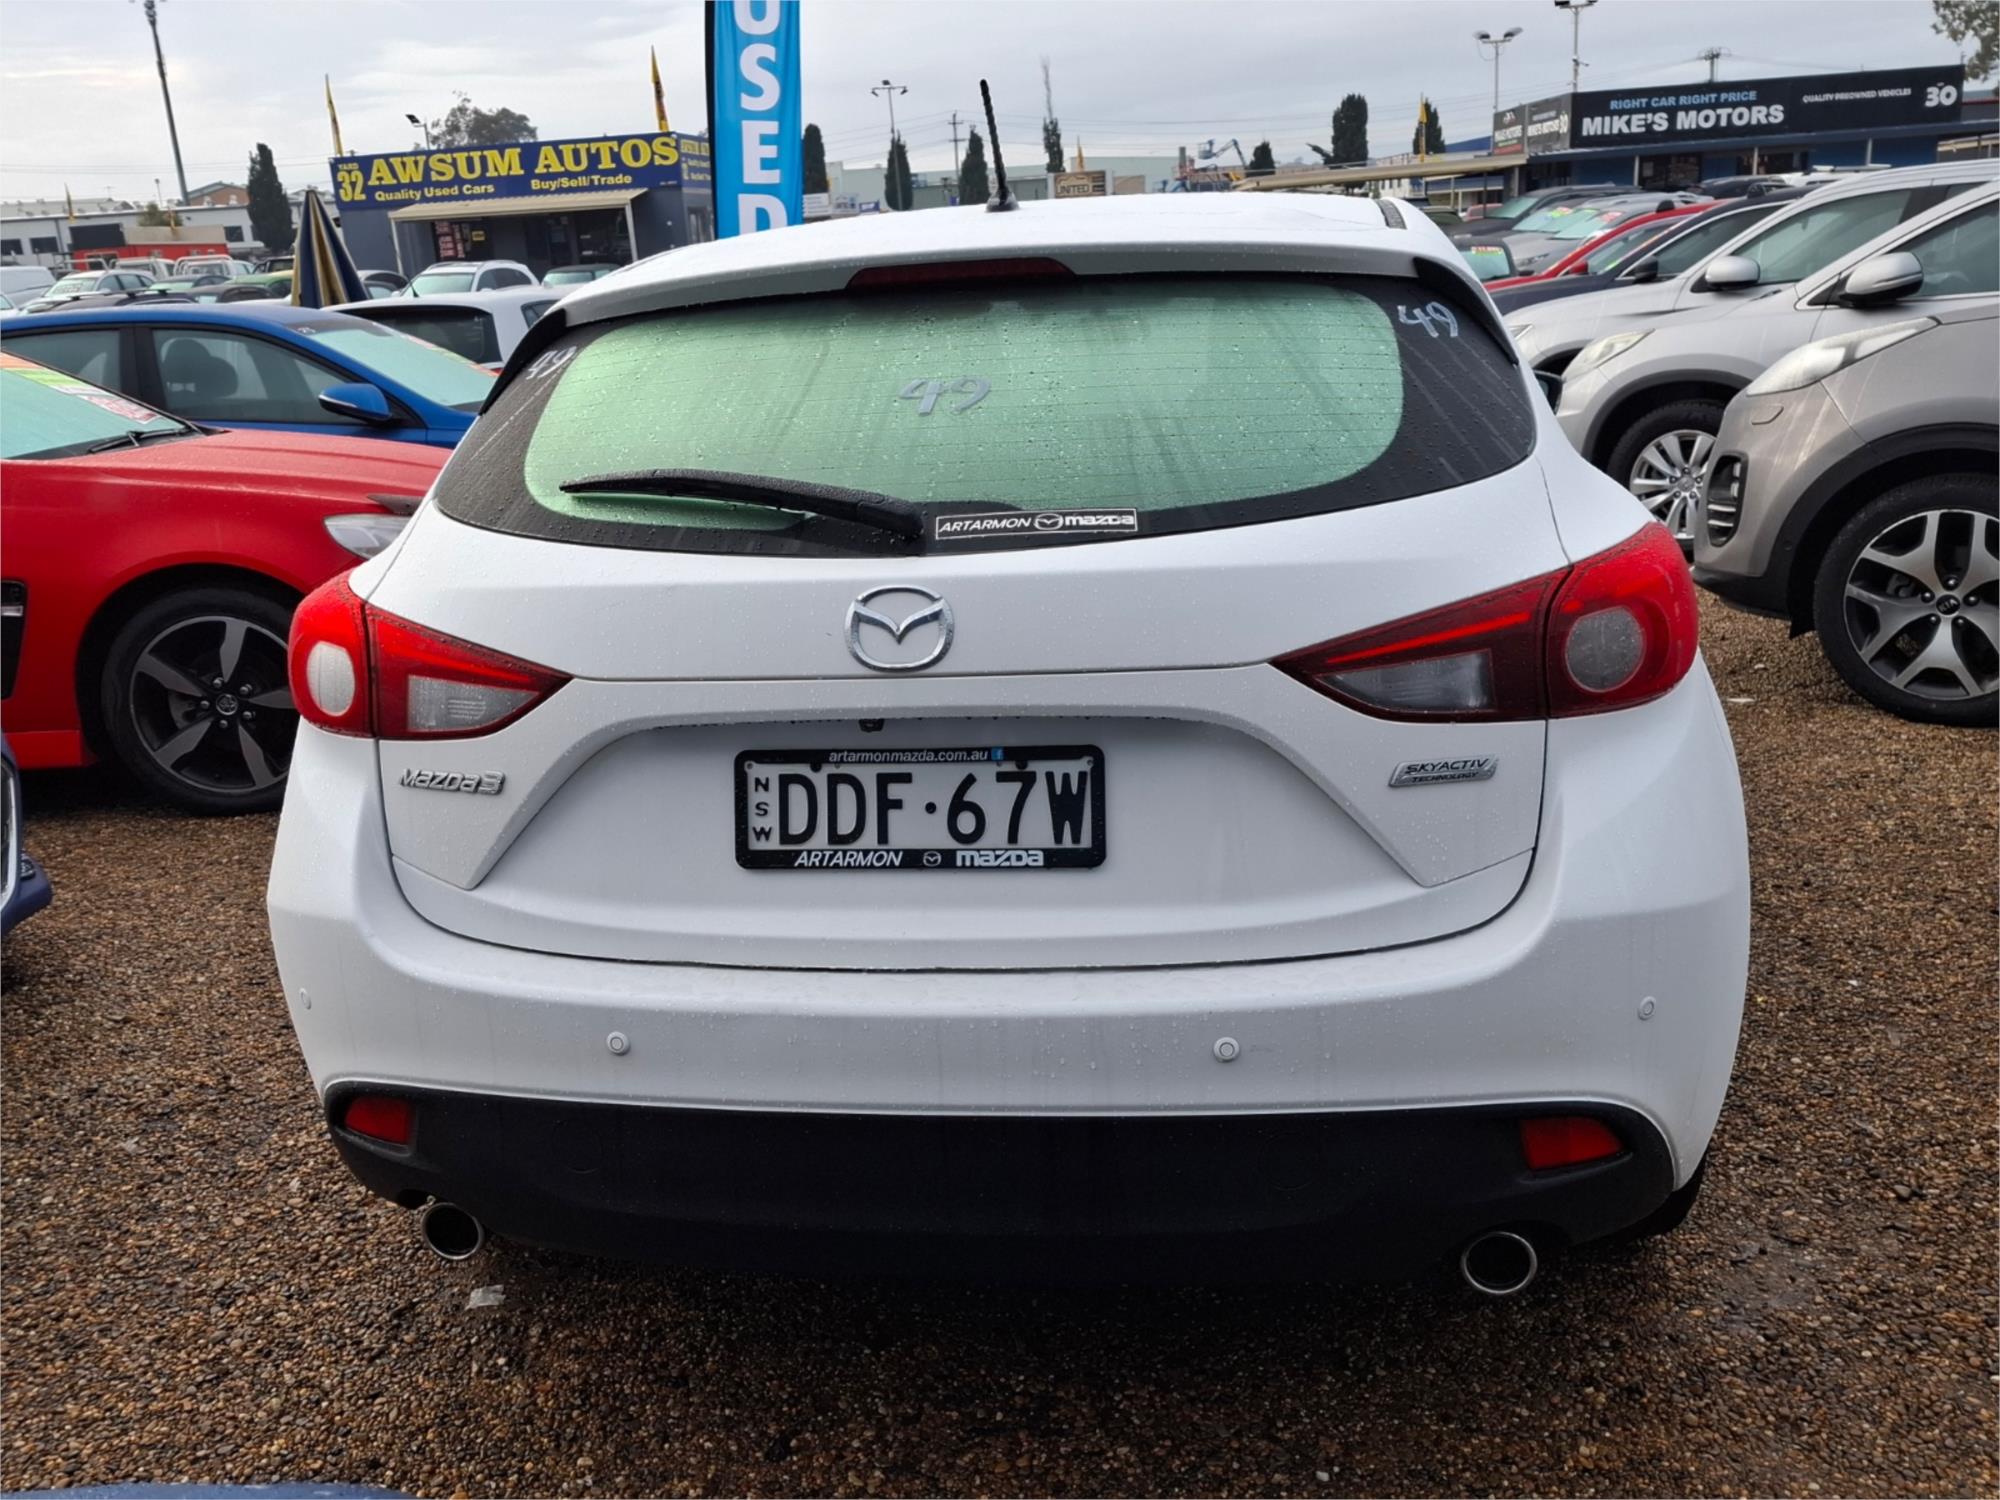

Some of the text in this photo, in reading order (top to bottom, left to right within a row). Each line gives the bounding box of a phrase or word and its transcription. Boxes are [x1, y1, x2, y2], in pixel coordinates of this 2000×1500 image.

[1609, 90, 1758, 110] RIGHT CAR RIGHT PRICE
[1802, 93, 1834, 103] QUALITY
[1878, 87, 1912, 97] VEHICLES
[1924, 85, 1958, 108] 30
[1581, 112, 1669, 137] MIKE'S
[1675, 104, 1785, 131] MOTORS
[368, 147, 525, 186] AWSUM
[534, 136, 679, 174] AUTOS
[337, 170, 367, 202] 32
[374, 182, 495, 202] Quality Used Cars
[530, 173, 633, 191] Buy/Sell/Trade
[1397, 301, 1459, 338] 49
[525, 346, 577, 380] 49
[899, 375, 992, 417] 49
[938, 515, 1135, 532] ARTARMON mazda
[828, 749, 989, 763] artarmonmazda.com.au
[1405, 758, 1489, 775] SKYACTIV
[1411, 771, 1479, 783] TECHNOLOGY
[794, 850, 1044, 868] ARTARMON mazda
